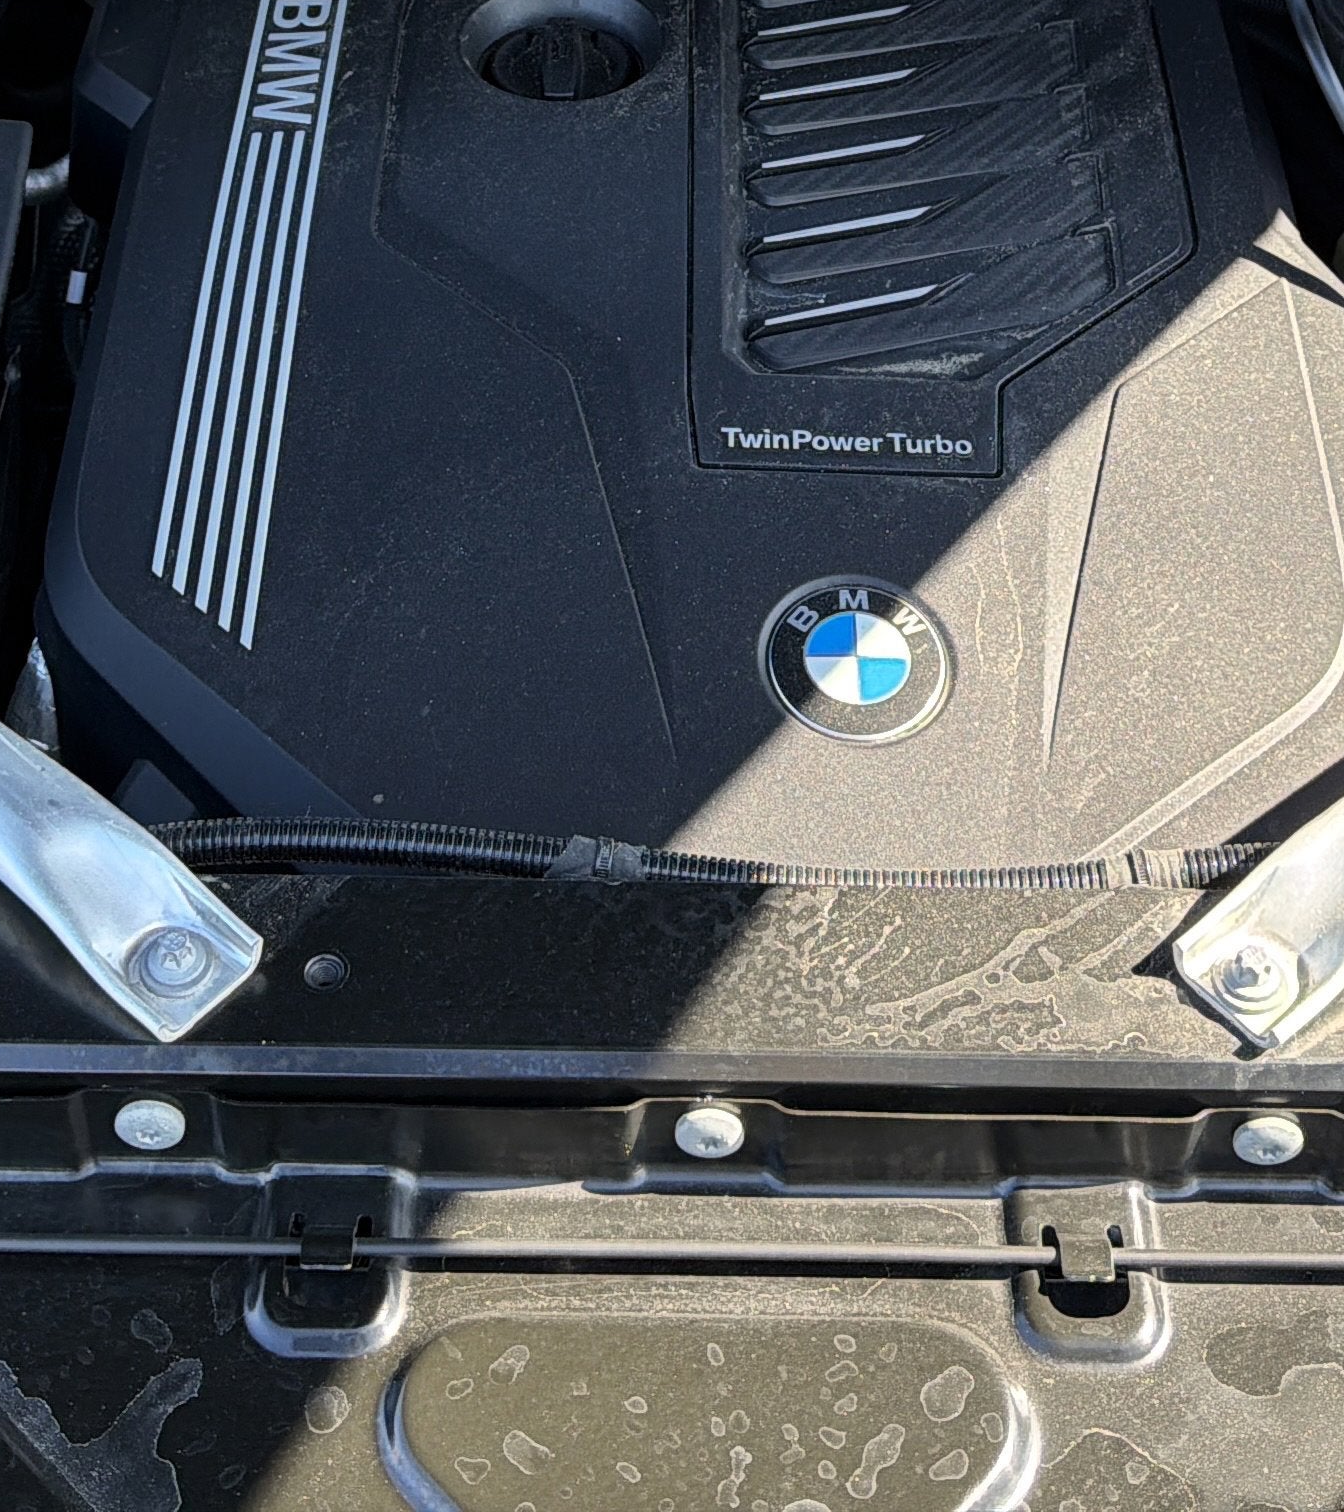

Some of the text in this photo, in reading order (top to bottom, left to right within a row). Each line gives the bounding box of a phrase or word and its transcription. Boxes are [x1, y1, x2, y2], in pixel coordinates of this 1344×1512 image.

[720, 427, 973, 455] TwinPower Turbo
[786, 589, 927, 636] BMW
